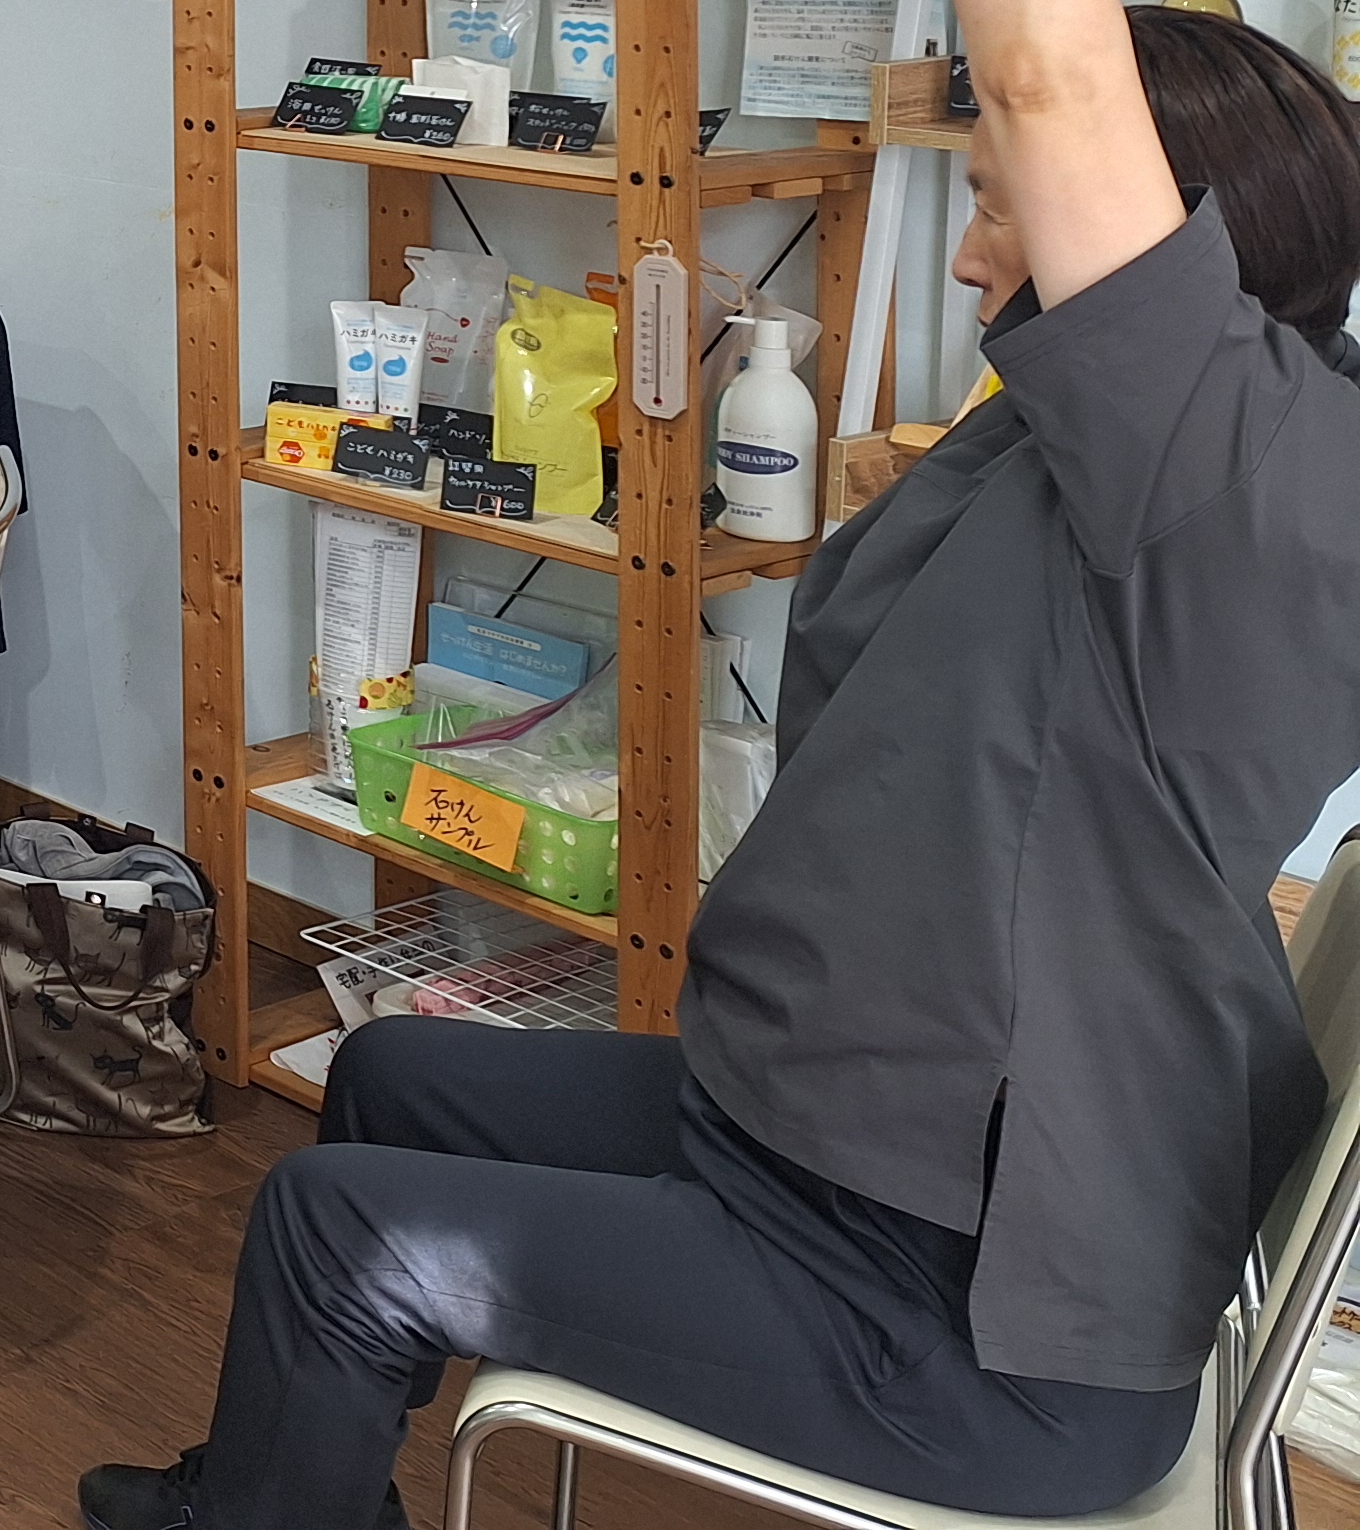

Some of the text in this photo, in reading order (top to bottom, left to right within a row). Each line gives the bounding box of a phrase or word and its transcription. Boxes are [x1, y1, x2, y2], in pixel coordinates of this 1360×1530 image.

[379, 333, 419, 346] ハミガキ
[427, 331, 459, 344] Hand
[426, 341, 455, 357] Soap
[734, 452, 795, 467] SHAMPOO
[425, 789, 483, 824] 石けん
[424, 812, 495, 851] サンプル
